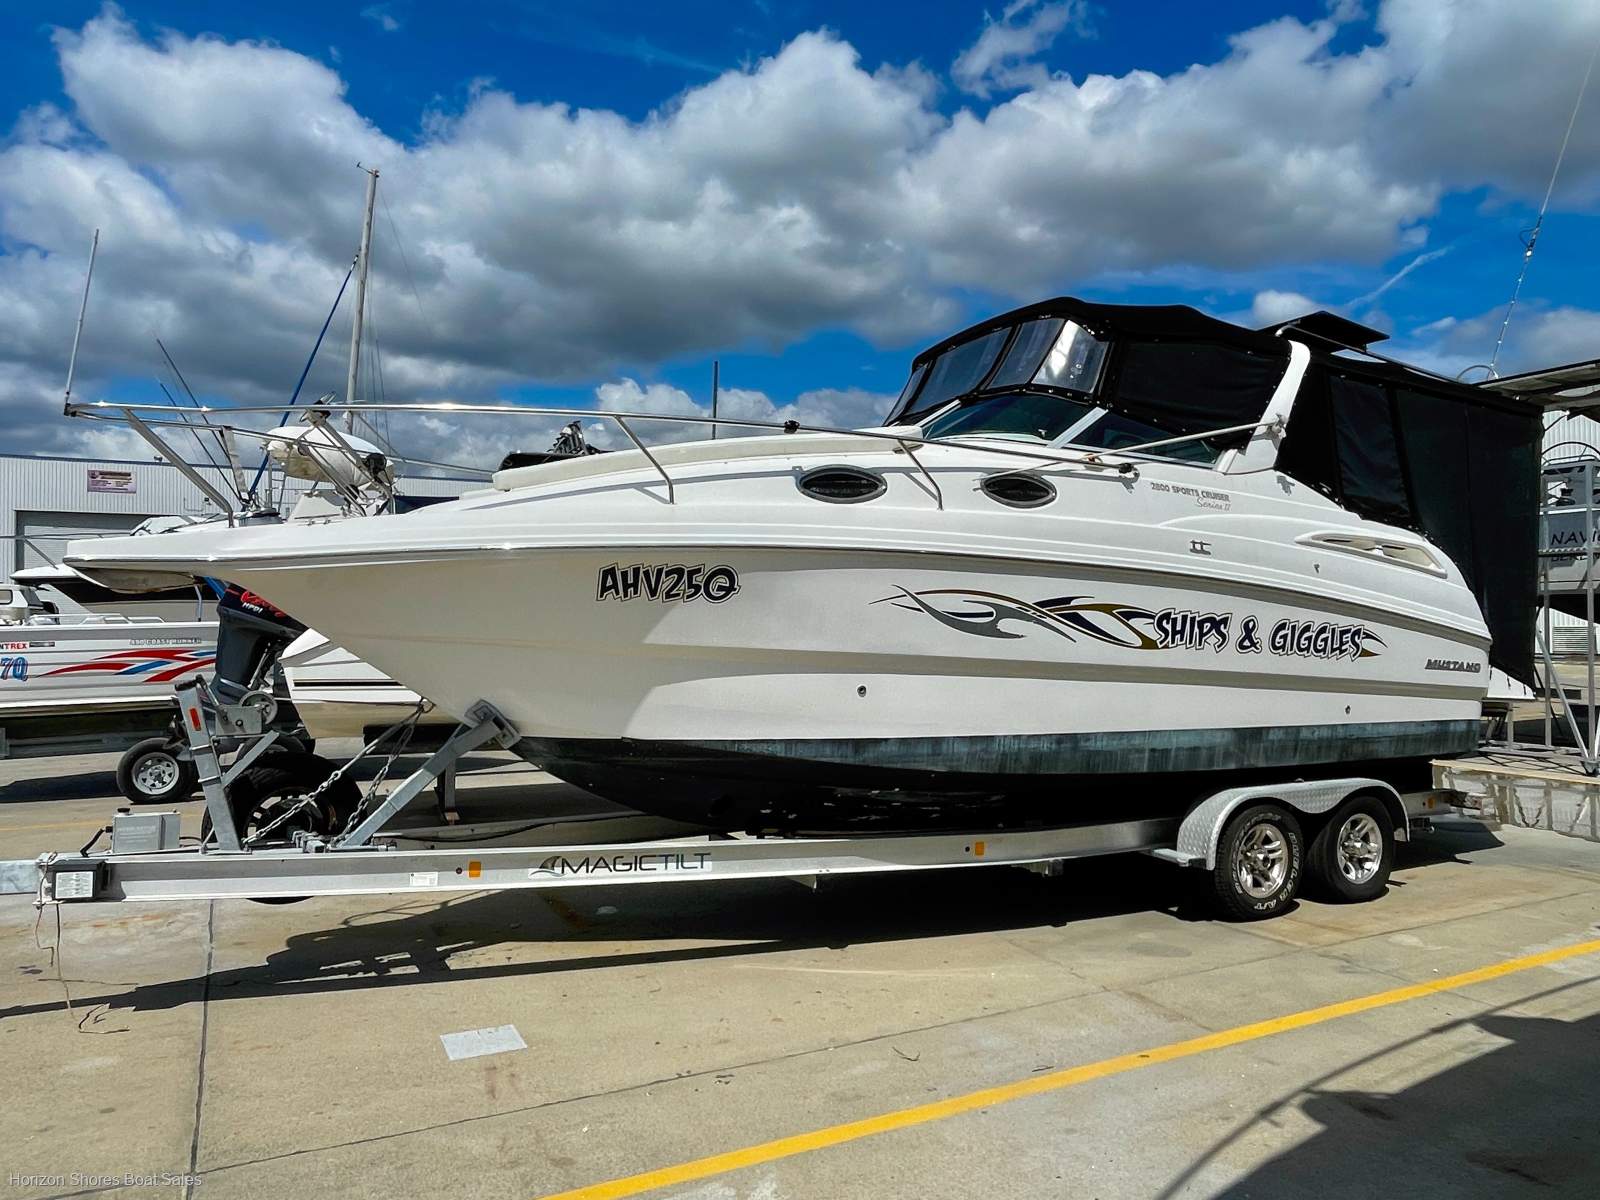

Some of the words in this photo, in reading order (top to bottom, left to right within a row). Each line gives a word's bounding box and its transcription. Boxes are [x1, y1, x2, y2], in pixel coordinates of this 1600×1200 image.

[1172, 485, 1200, 497] SPORTS
[1201, 490, 1231, 502] CRUISER
[596, 562, 742, 604] AHV25Q
[1153, 607, 1233, 654] SHIPS
[1235, 614, 1262, 654] &
[1268, 618, 1365, 662] GIGGLES
[1424, 659, 1481, 673] MUSTANG
[560, 852, 712, 875] MAGICTILT
